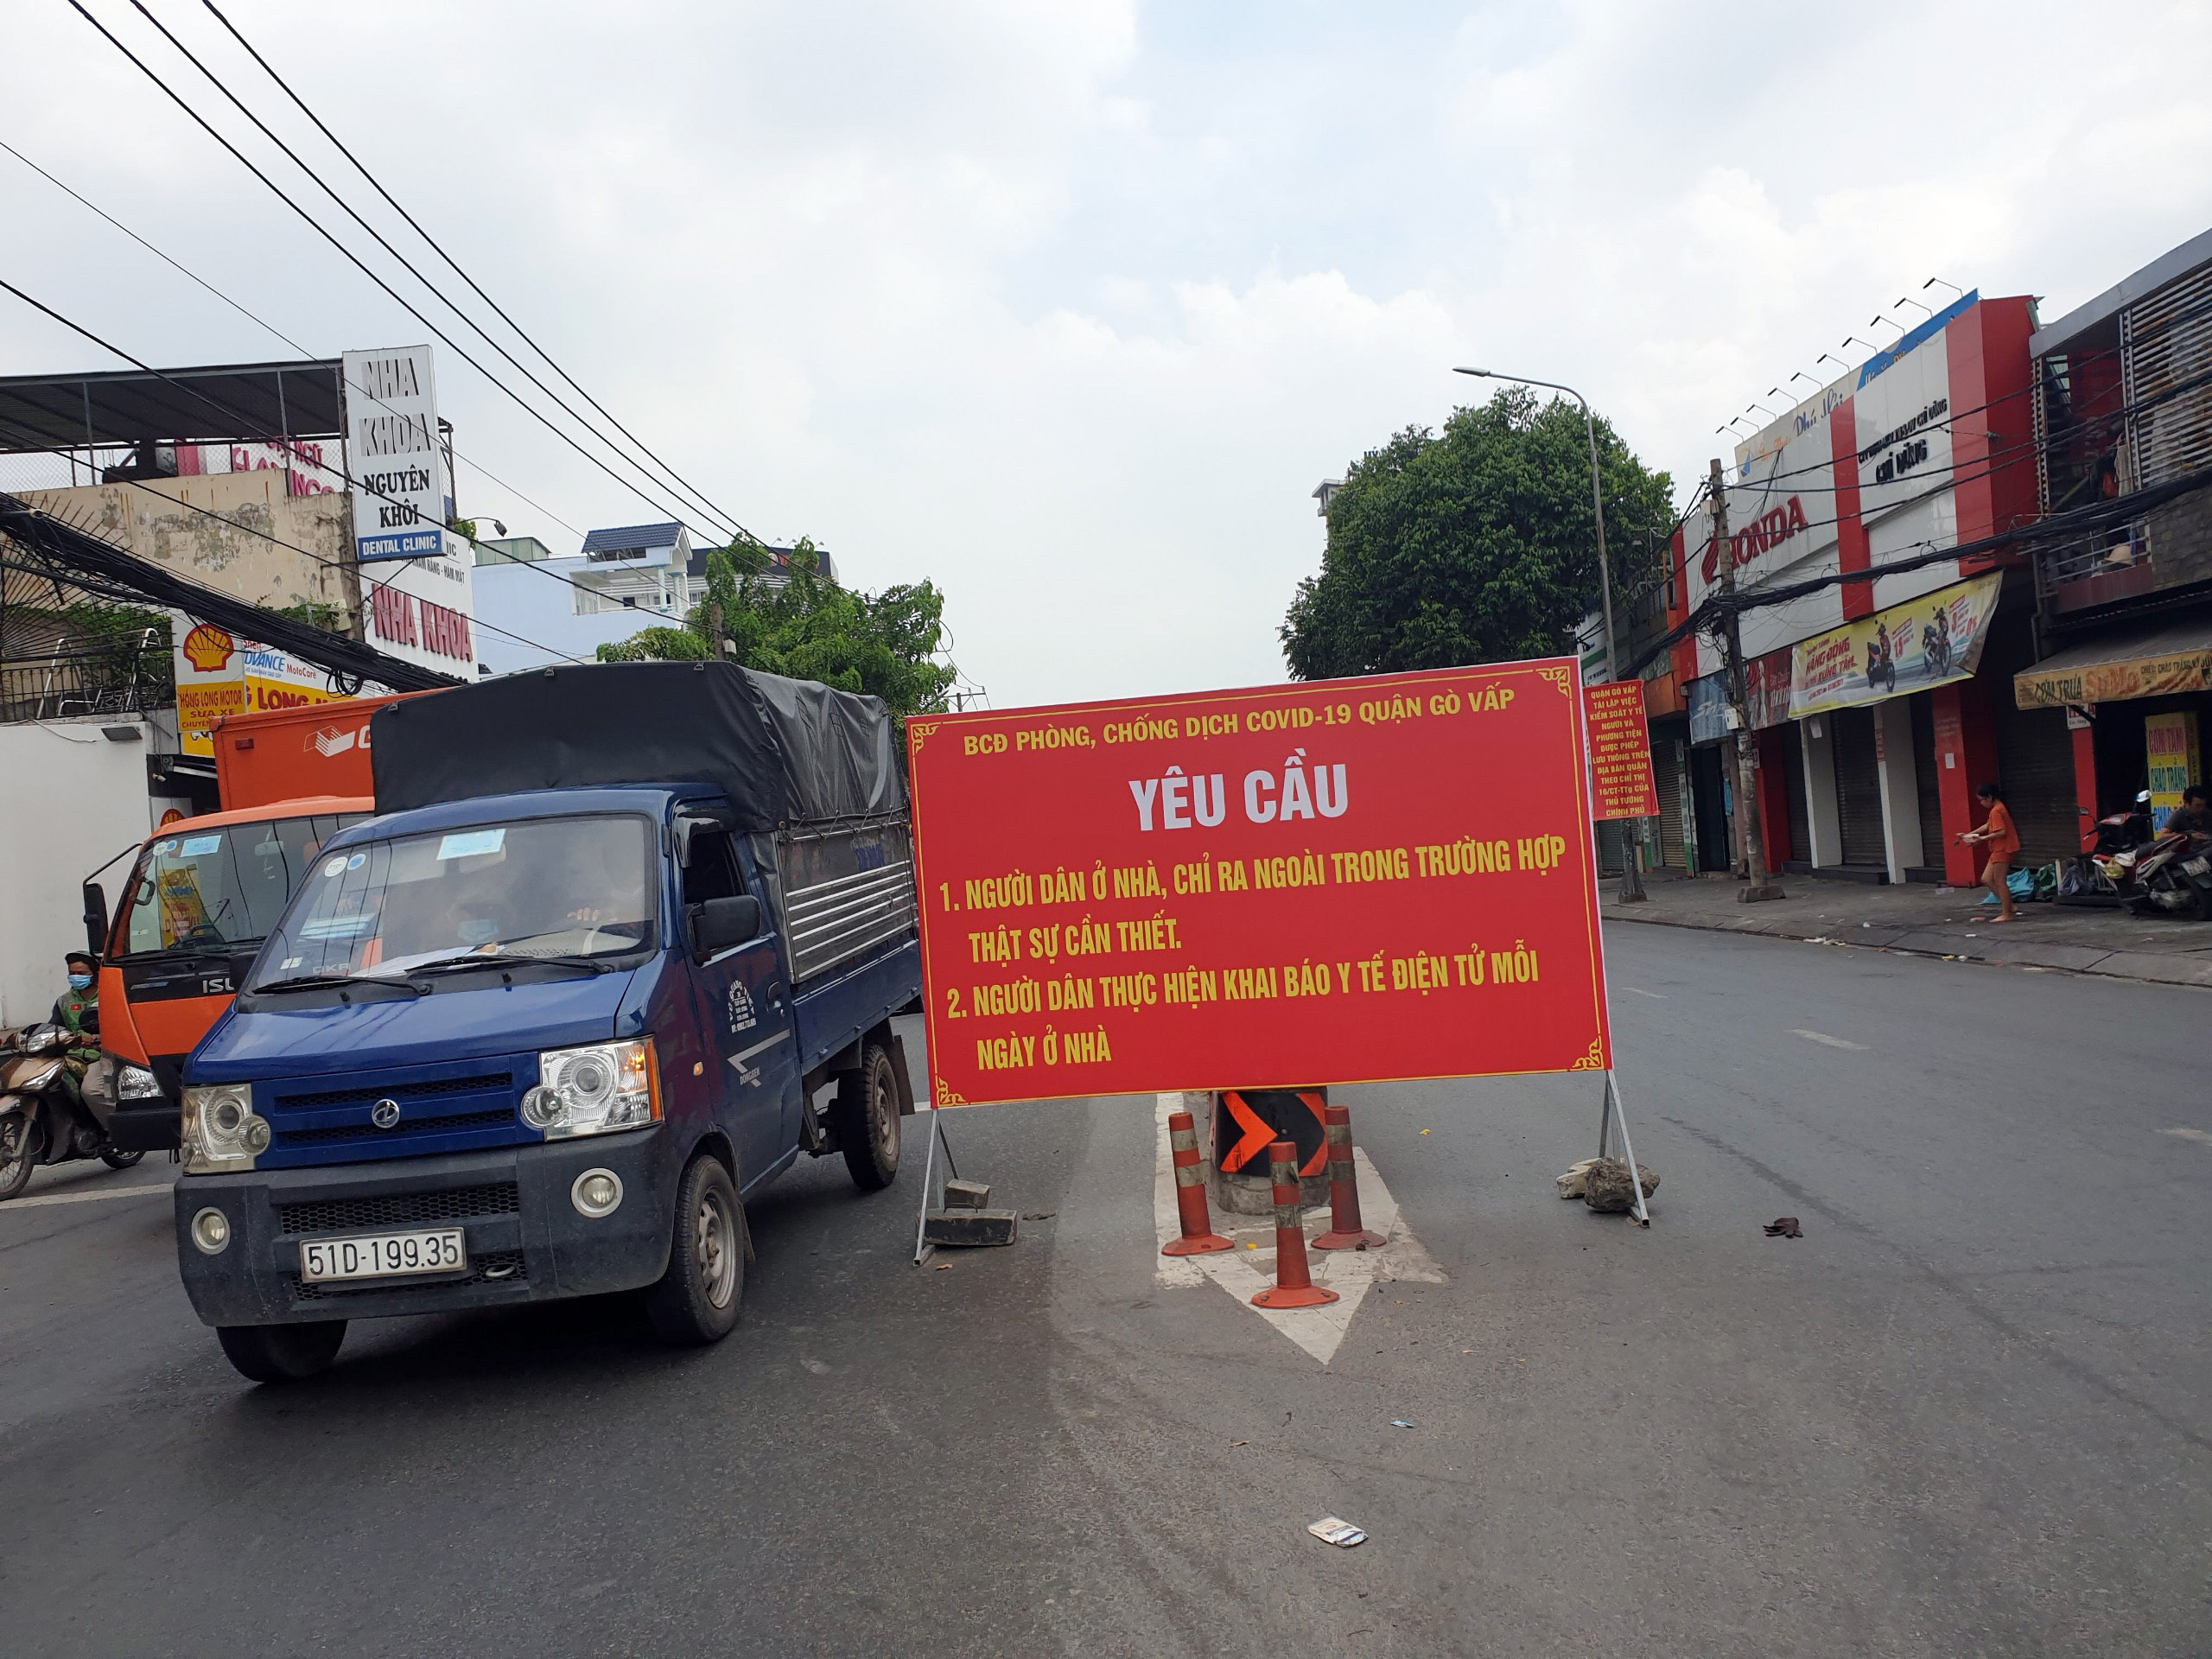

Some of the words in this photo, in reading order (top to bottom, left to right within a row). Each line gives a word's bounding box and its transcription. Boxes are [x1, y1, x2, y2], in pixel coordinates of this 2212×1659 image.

[359, 357, 419, 401] NHA
[359, 412, 431, 457] KHOA
[362, 538, 400, 556] DENTAL
[402, 535, 437, 552] CLINIC
[372, 582, 419, 648] NHA
[419, 599, 474, 663] KHOA
[244, 650, 286, 672] DVANCE
[286, 664, 317, 680] MotoCare
[200, 691, 219, 708] LONG
[219, 690, 243, 706] MOTOR
[257, 687, 309, 710] LONG
[963, 734, 1008, 755] BCĐ
[1016, 723, 1096, 751] PHÒNG,
[1103, 712, 1178, 744] CHỐNG
[1185, 713, 1238, 741] DỊCH
[1246, 703, 1351, 732] COVID-19
[1358, 694, 1422, 724] QUẬN
[1429, 687, 1461, 715] GÒ
[1467, 681, 1516, 713] VẤP
[1128, 765, 1226, 831] YÊU
[1243, 748, 1348, 823] CẦU
[939, 882, 960, 912] 1.
[965, 868, 1033, 910] NGƯỜI
[1039, 867, 1086, 905] DÂN
[1091, 859, 1107, 900] Ở
[1113, 860, 1167, 900] NHÀ,
[1173, 851, 1211, 894] CHỈ
[1217, 860, 1249, 892] RA
[1255, 849, 1325, 890] NGOÀI
[1331, 848, 1409, 884] TRONG
[1414, 835, 1511, 878] TRƯỜNG
[1517, 833, 1567, 876] HỢP
[969, 925, 1021, 968] THẬT
[1029, 923, 1059, 964] SỰ
[1065, 913, 1111, 955] CẦN
[1116, 909, 1182, 952] THIẾT.
[947, 988, 967, 1019] 2.
[973, 975, 1042, 1017] NGƯỜI
[1047, 973, 1094, 1011] DÂN
[1099, 971, 1157, 1013] THỰC
[1163, 964, 1217, 1009] HIỆN
[1223, 967, 1277, 1001] KHAI
[1283, 958, 1331, 998] BÁO
[1336, 963, 1351, 994] Y
[1357, 950, 1386, 993] TẾ
[1392, 950, 1449, 995] ĐIỆN
[1454, 943, 1484, 986] TỬ
[1491, 939, 1539, 984] MỖI
[976, 1031, 1035, 1071] NGÀY
[1042, 1024, 1057, 1066] Ở
[1065, 1024, 1111, 1064] NHÀ
[308, 1235, 459, 1275] 51D-199.35
